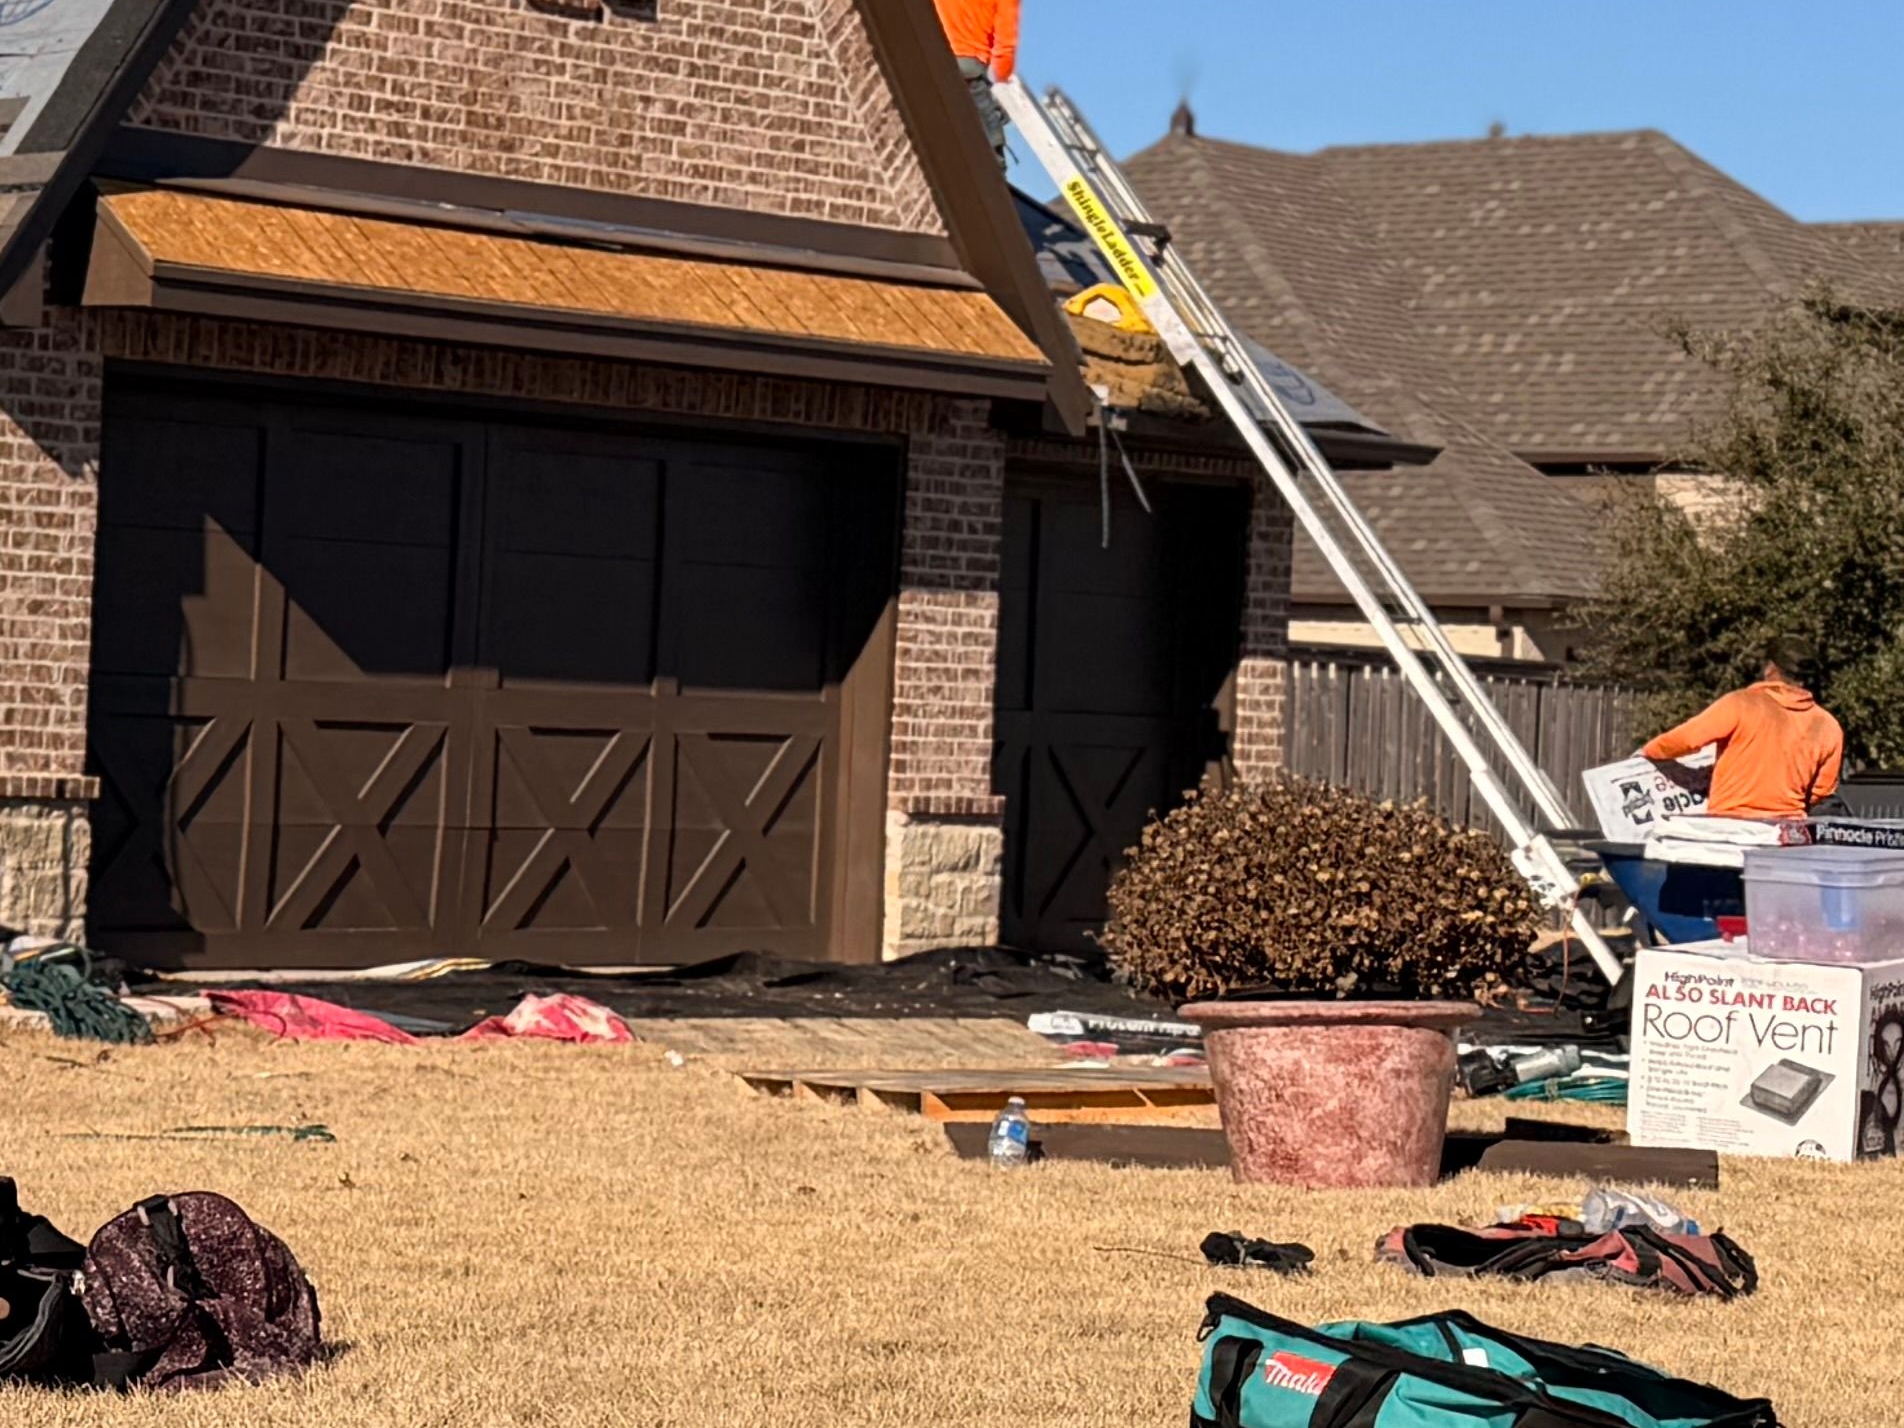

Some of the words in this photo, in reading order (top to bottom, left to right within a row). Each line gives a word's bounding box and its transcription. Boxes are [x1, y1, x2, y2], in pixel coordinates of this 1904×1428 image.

[1816, 822, 1874, 845] Pinnacle
[1664, 971, 1736, 990] HighPoint
[1709, 988, 1776, 1010] SLANT
[1782, 996, 1837, 1016] BACK
[1643, 1003, 1740, 1045] Roof
[1749, 1013, 1839, 1056] Vent
